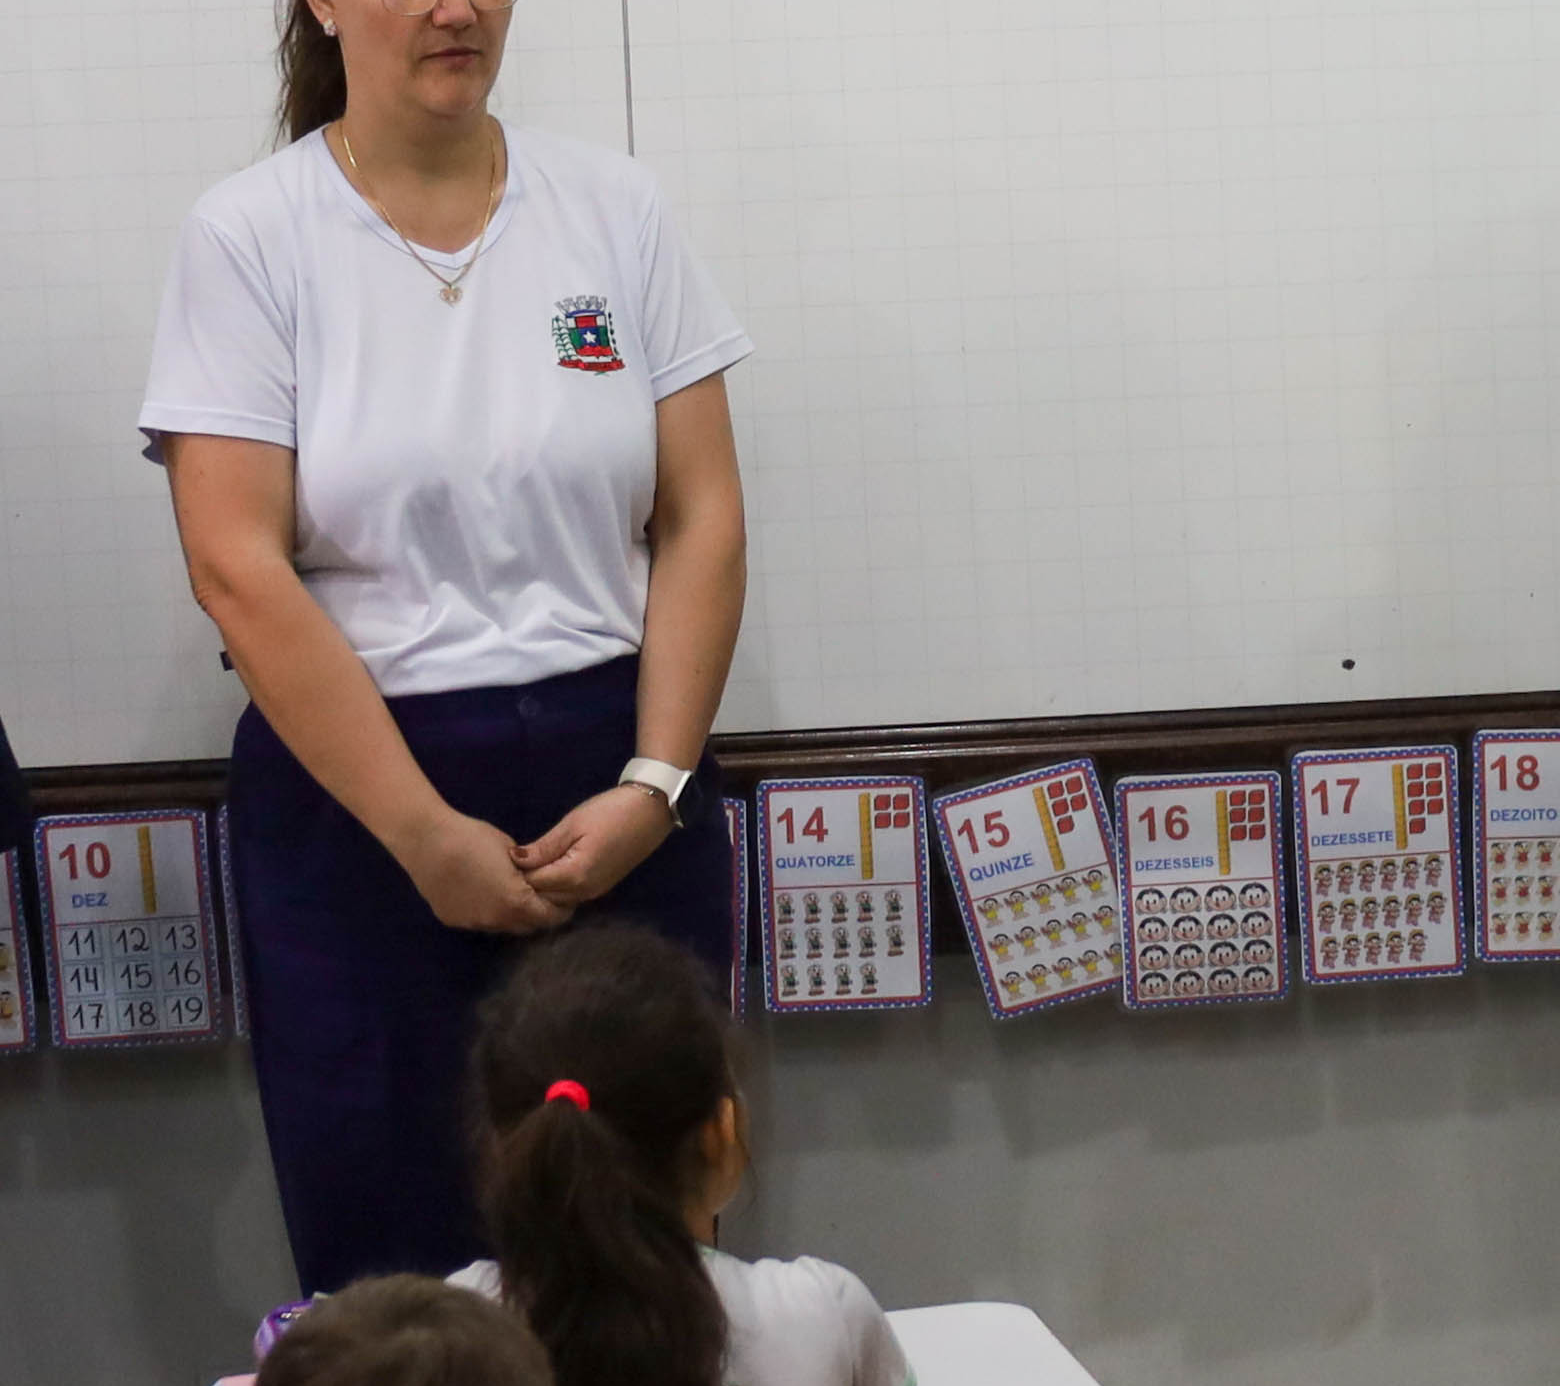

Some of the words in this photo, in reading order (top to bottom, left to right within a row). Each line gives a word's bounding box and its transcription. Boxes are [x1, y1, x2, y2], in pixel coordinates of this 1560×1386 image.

[1489, 754, 1541, 793] 18
[1309, 776, 1362, 817] 17
[776, 806, 829, 846] 14
[955, 808, 1013, 856] 15
[1137, 804, 1191, 844] 16
[1489, 807, 1558, 822] DEZOITO
[1310, 829, 1394, 848] DEZESSETE
[59, 841, 111, 881] 10
[775, 854, 857, 870] QUATORZE
[968, 851, 1036, 883] QUINZE
[1133, 854, 1216, 873] DEZESSEIS
[71, 892, 108, 909] DEZ
